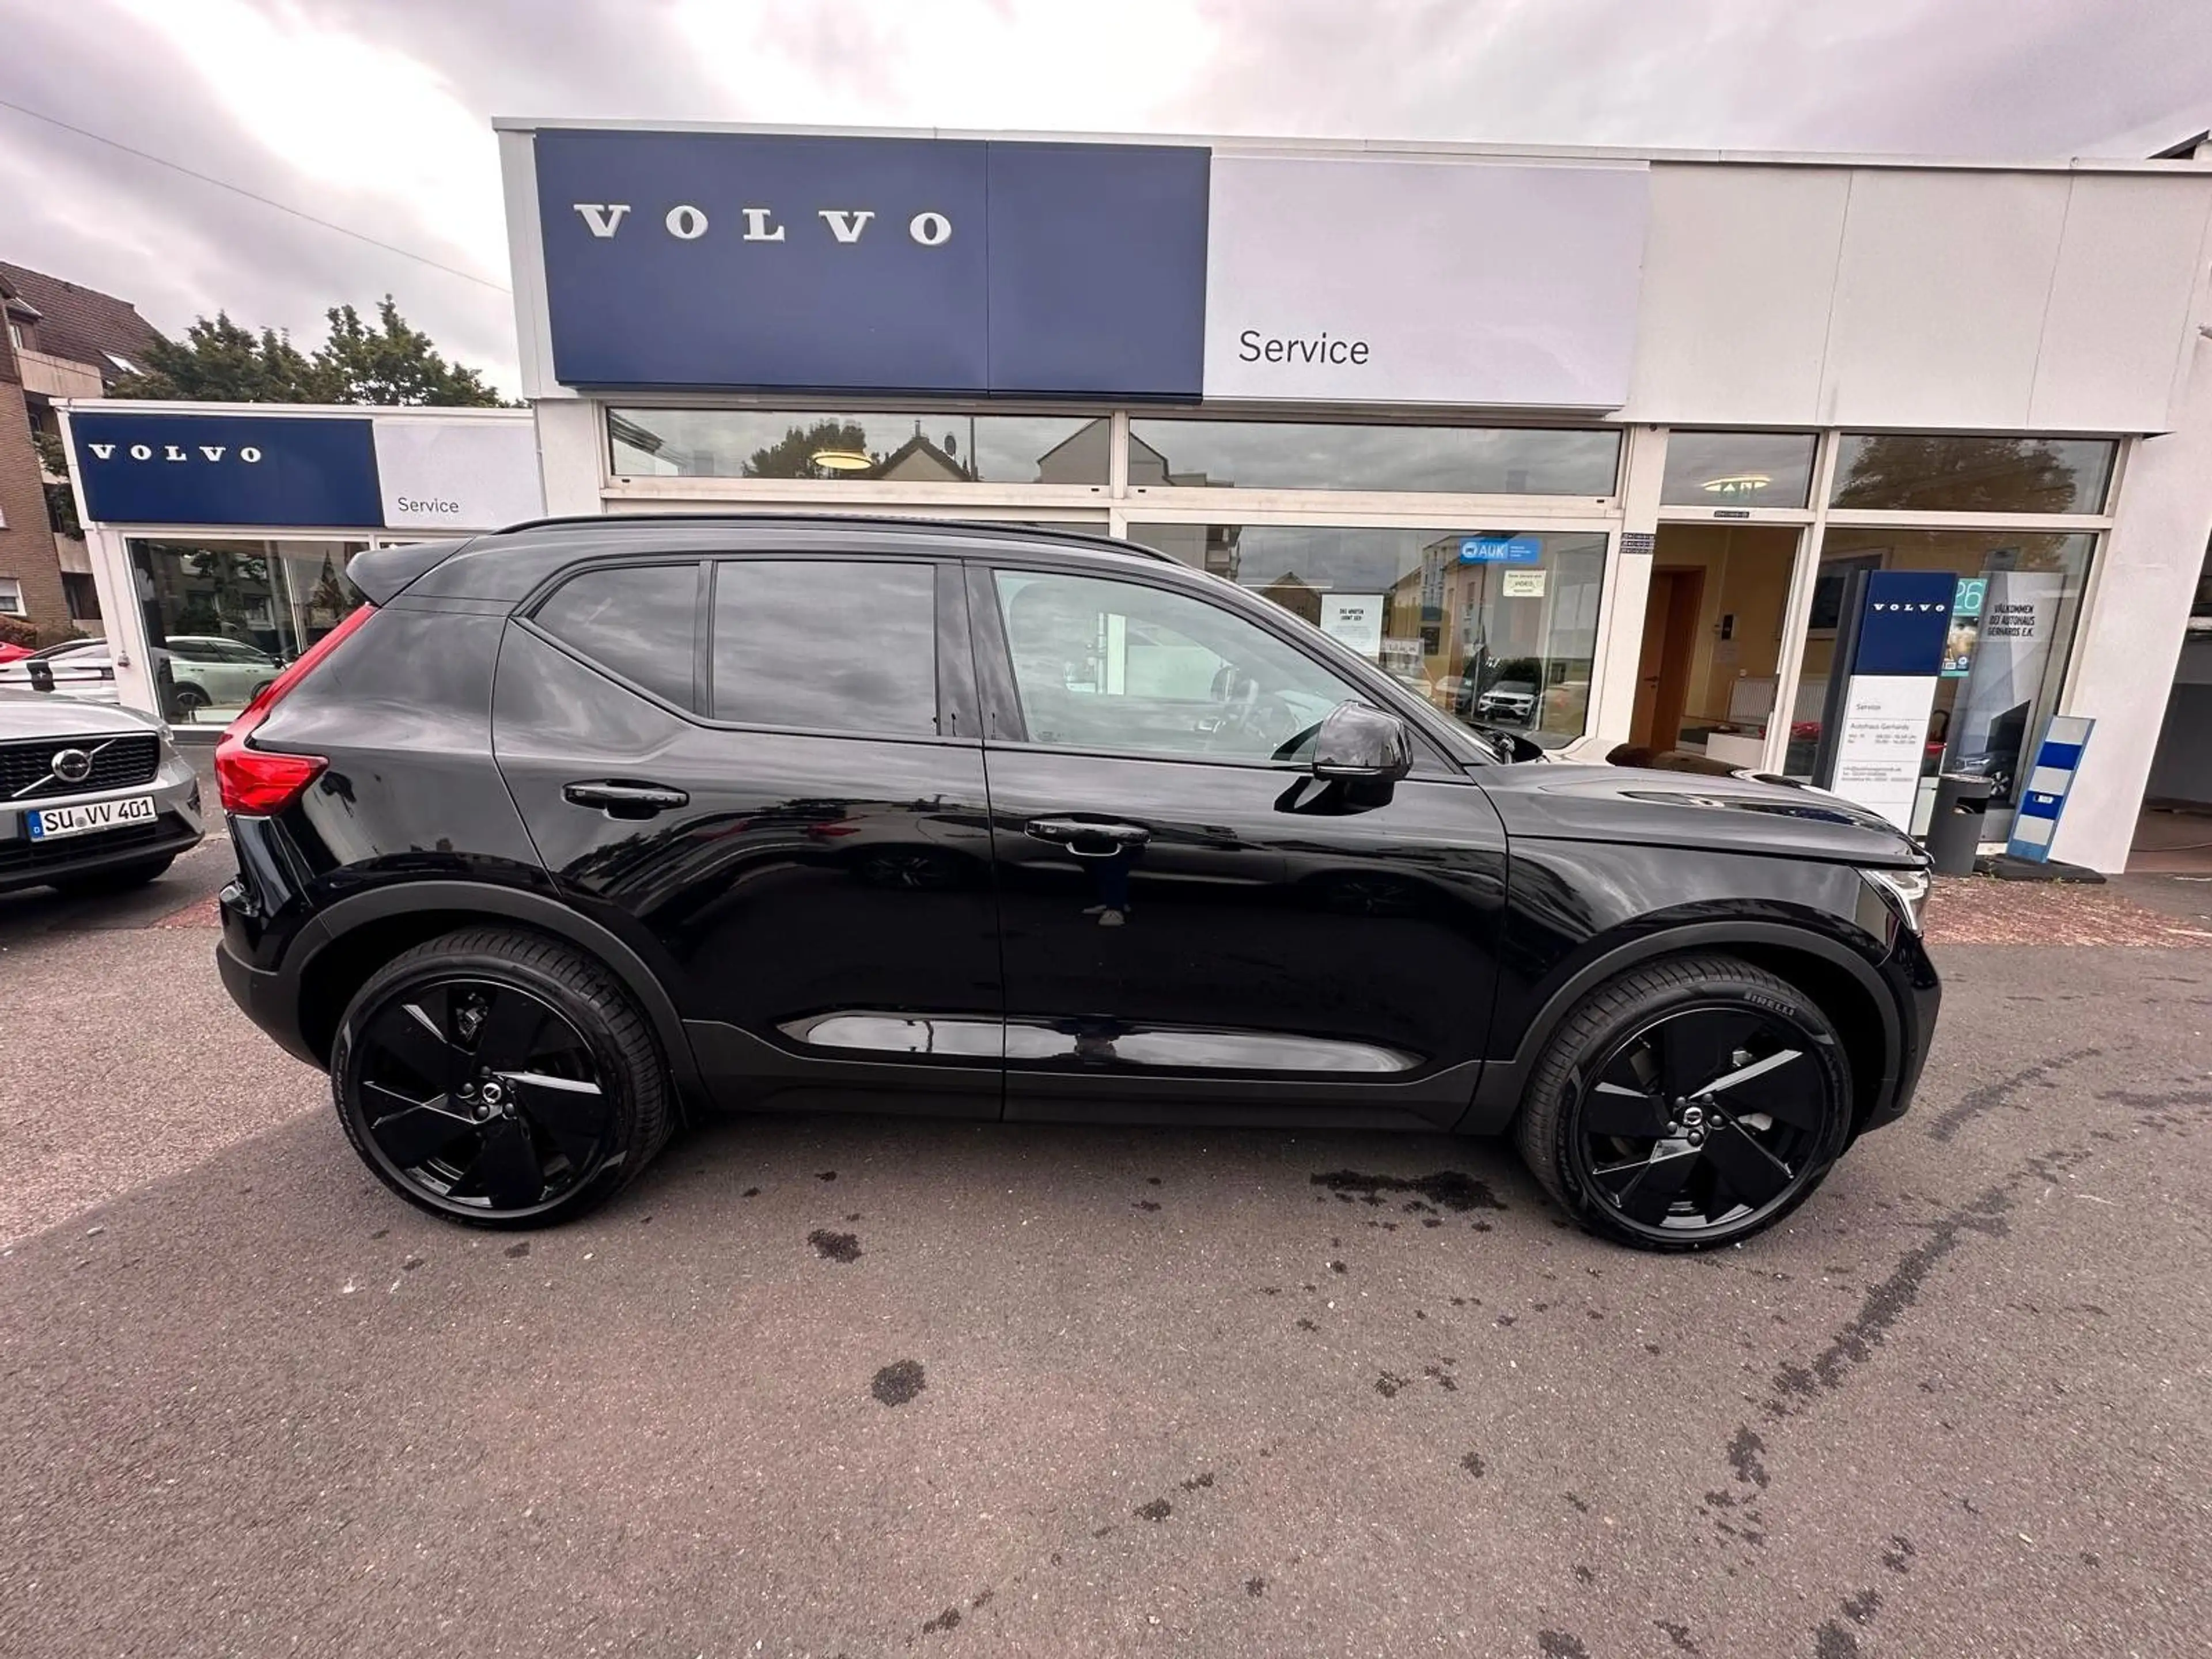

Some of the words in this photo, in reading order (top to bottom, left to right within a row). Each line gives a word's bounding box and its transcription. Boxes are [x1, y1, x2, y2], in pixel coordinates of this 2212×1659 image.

[574, 204, 952, 246] VOLVO
[1238, 330, 1370, 365] Service
[88, 444, 262, 463] VOLVO
[397, 497, 459, 513] Service
[1873, 604, 1945, 612] VOLVO
[44, 810, 74, 832] SU
[85, 805, 111, 825] VV
[118, 799, 153, 820] 401
